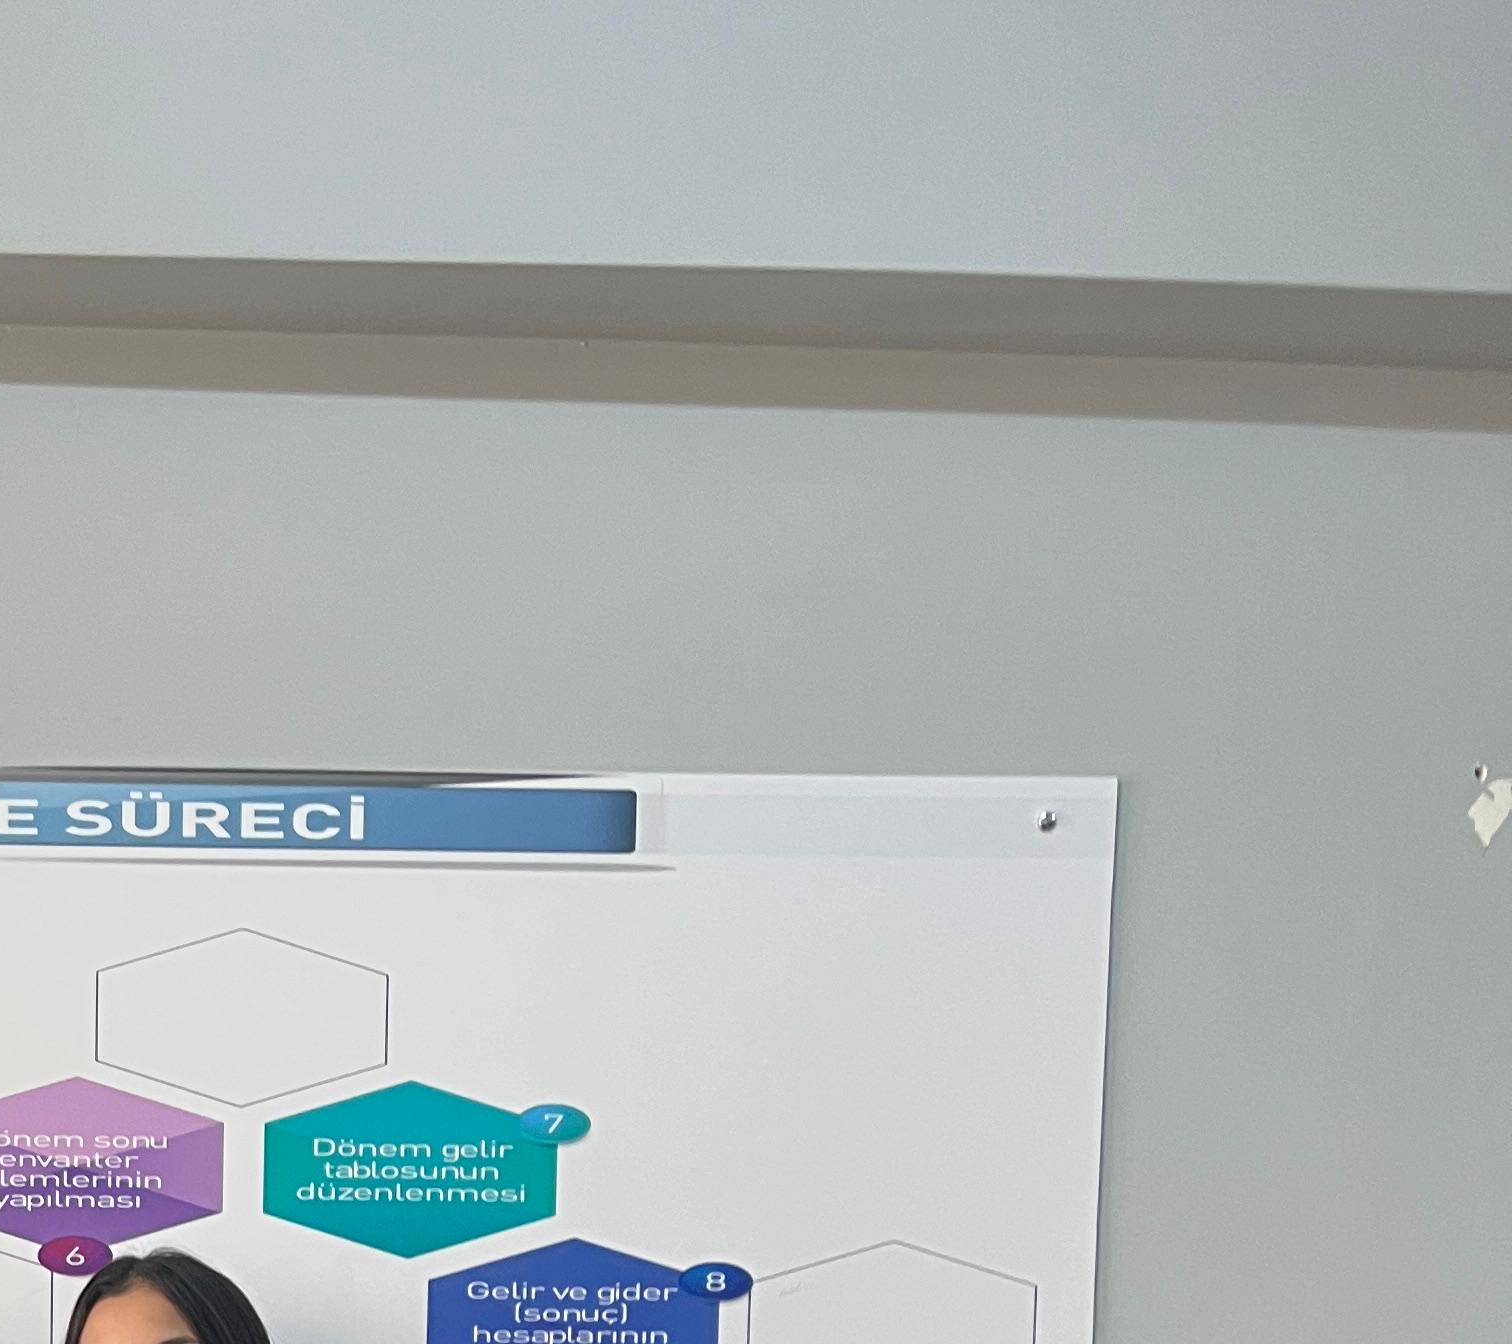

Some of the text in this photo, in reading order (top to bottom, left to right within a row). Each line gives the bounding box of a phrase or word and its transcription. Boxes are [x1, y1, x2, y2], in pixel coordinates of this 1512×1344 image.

[65, 790, 368, 843] SÜRECİ
[544, 1114, 564, 1133] 7
[93, 1133, 169, 1150] sonu
[311, 1138, 515, 1164] Dönem gelir
[322, 1160, 500, 1182] tablosunun
[295, 1182, 527, 1204] düzenlenmesi
[65, 1246, 86, 1267] 6
[704, 1272, 727, 1292] 8
[465, 1281, 680, 1309] Gelir ve gider
[513, 1302, 629, 1327] (sonuç)
